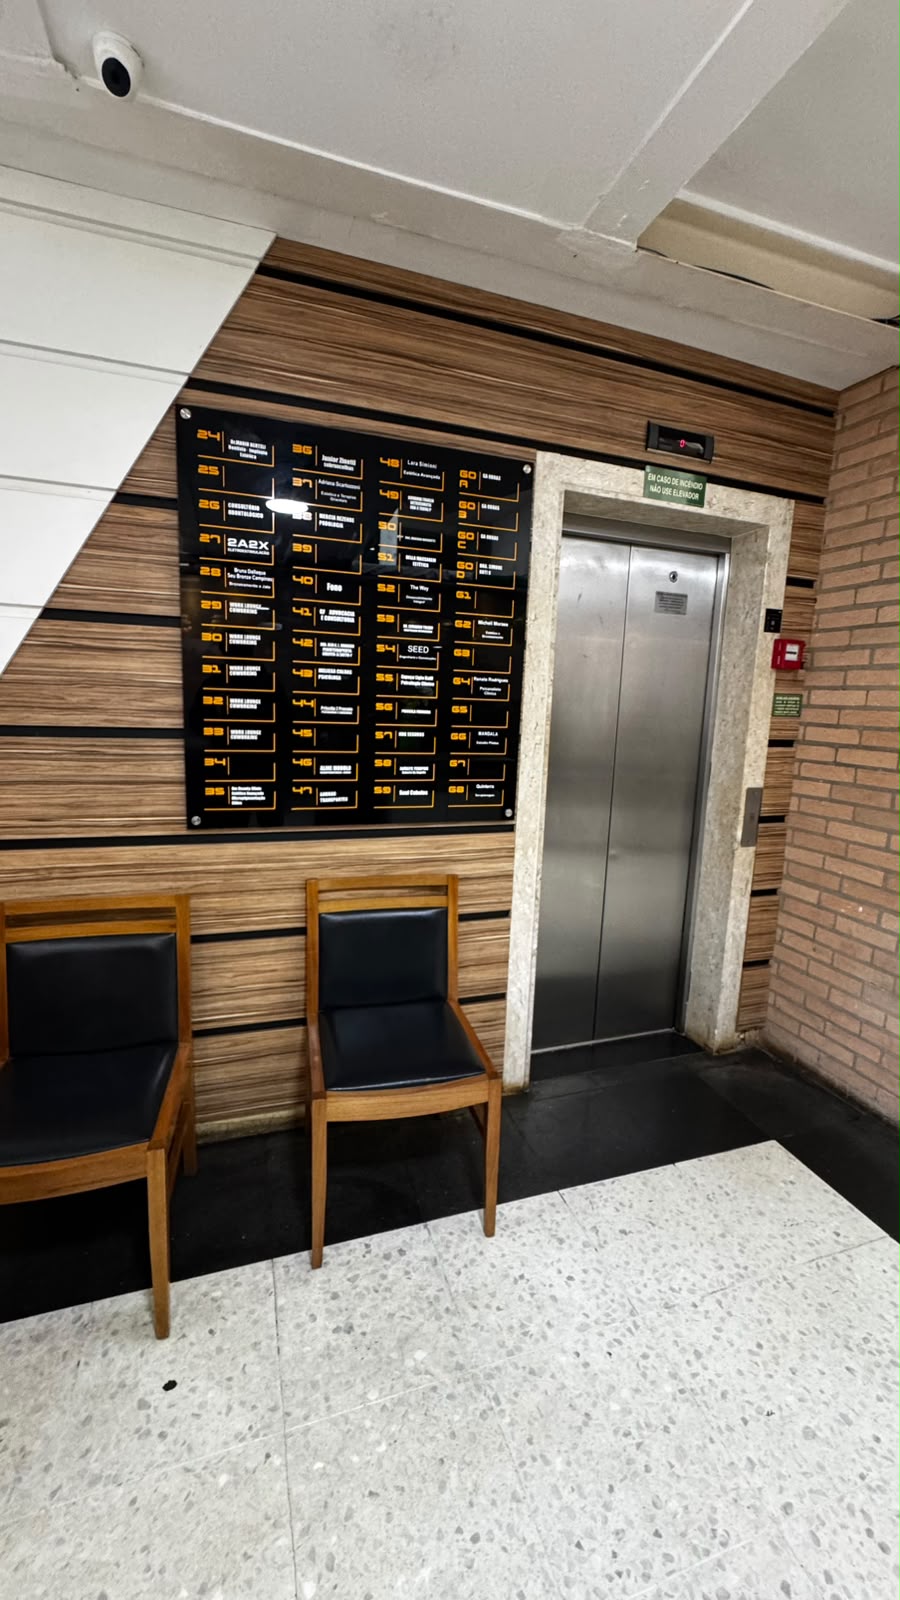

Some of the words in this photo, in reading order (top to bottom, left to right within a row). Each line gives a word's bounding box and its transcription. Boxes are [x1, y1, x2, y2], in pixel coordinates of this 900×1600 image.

[197, 429, 221, 441] 24
[292, 443, 313, 455] 36
[379, 457, 400, 468] 48
[407, 459, 419, 467] Lara
[197, 464, 220, 476] 25
[292, 477, 313, 489] 37
[459, 479, 468, 489] A
[647, 473, 657, 481] EM
[656, 475, 672, 484] CASO
[671, 478, 679, 486] DE
[680, 479, 704, 491] INCÊNDIO
[379, 489, 400, 500] 49
[649, 483, 661, 494] NÃO
[662, 487, 673, 496] USE
[672, 489, 700, 500] ELEVADOR
[198, 499, 220, 510] 26
[458, 510, 467, 519] B
[378, 520, 397, 531] 50
[199, 533, 221, 544] 27
[227, 537, 270, 551] 2A2X
[292, 542, 313, 553] 39
[457, 541, 466, 549] C
[377, 552, 395, 562] 51
[199, 566, 222, 577] 28
[456, 570, 465, 579] D
[292, 575, 314, 585] 40
[326, 582, 343, 592] Fono
[377, 583, 396, 593] 52
[455, 590, 471, 600] 61
[200, 599, 222, 610] 29
[292, 606, 312, 616] 41
[376, 613, 395, 623] 53
[454, 619, 472, 629] 62
[201, 631, 223, 642] 30
[292, 637, 313, 647] 42
[376, 643, 396, 653] 54
[407, 645, 430, 654] SEED
[453, 648, 470, 657] 63
[202, 663, 222, 674] 31
[292, 668, 313, 678] 43
[375, 673, 394, 682] 55
[453, 677, 471, 686] 64
[202, 695, 224, 705] 32
[292, 699, 314, 708] 44
[375, 702, 393, 711] 56
[451, 705, 468, 714] 65
[203, 727, 224, 736] 33
[292, 728, 313, 737] 45
[375, 731, 393, 740] 57
[450, 732, 467, 740] 66
[204, 757, 226, 767] 34
[292, 758, 313, 766] 46
[374, 759, 392, 767] 58
[449, 759, 466, 767] 67
[205, 787, 225, 796] 35
[292, 786, 313, 795] 47
[374, 786, 392, 794] 59
[448, 786, 465, 794] 68
